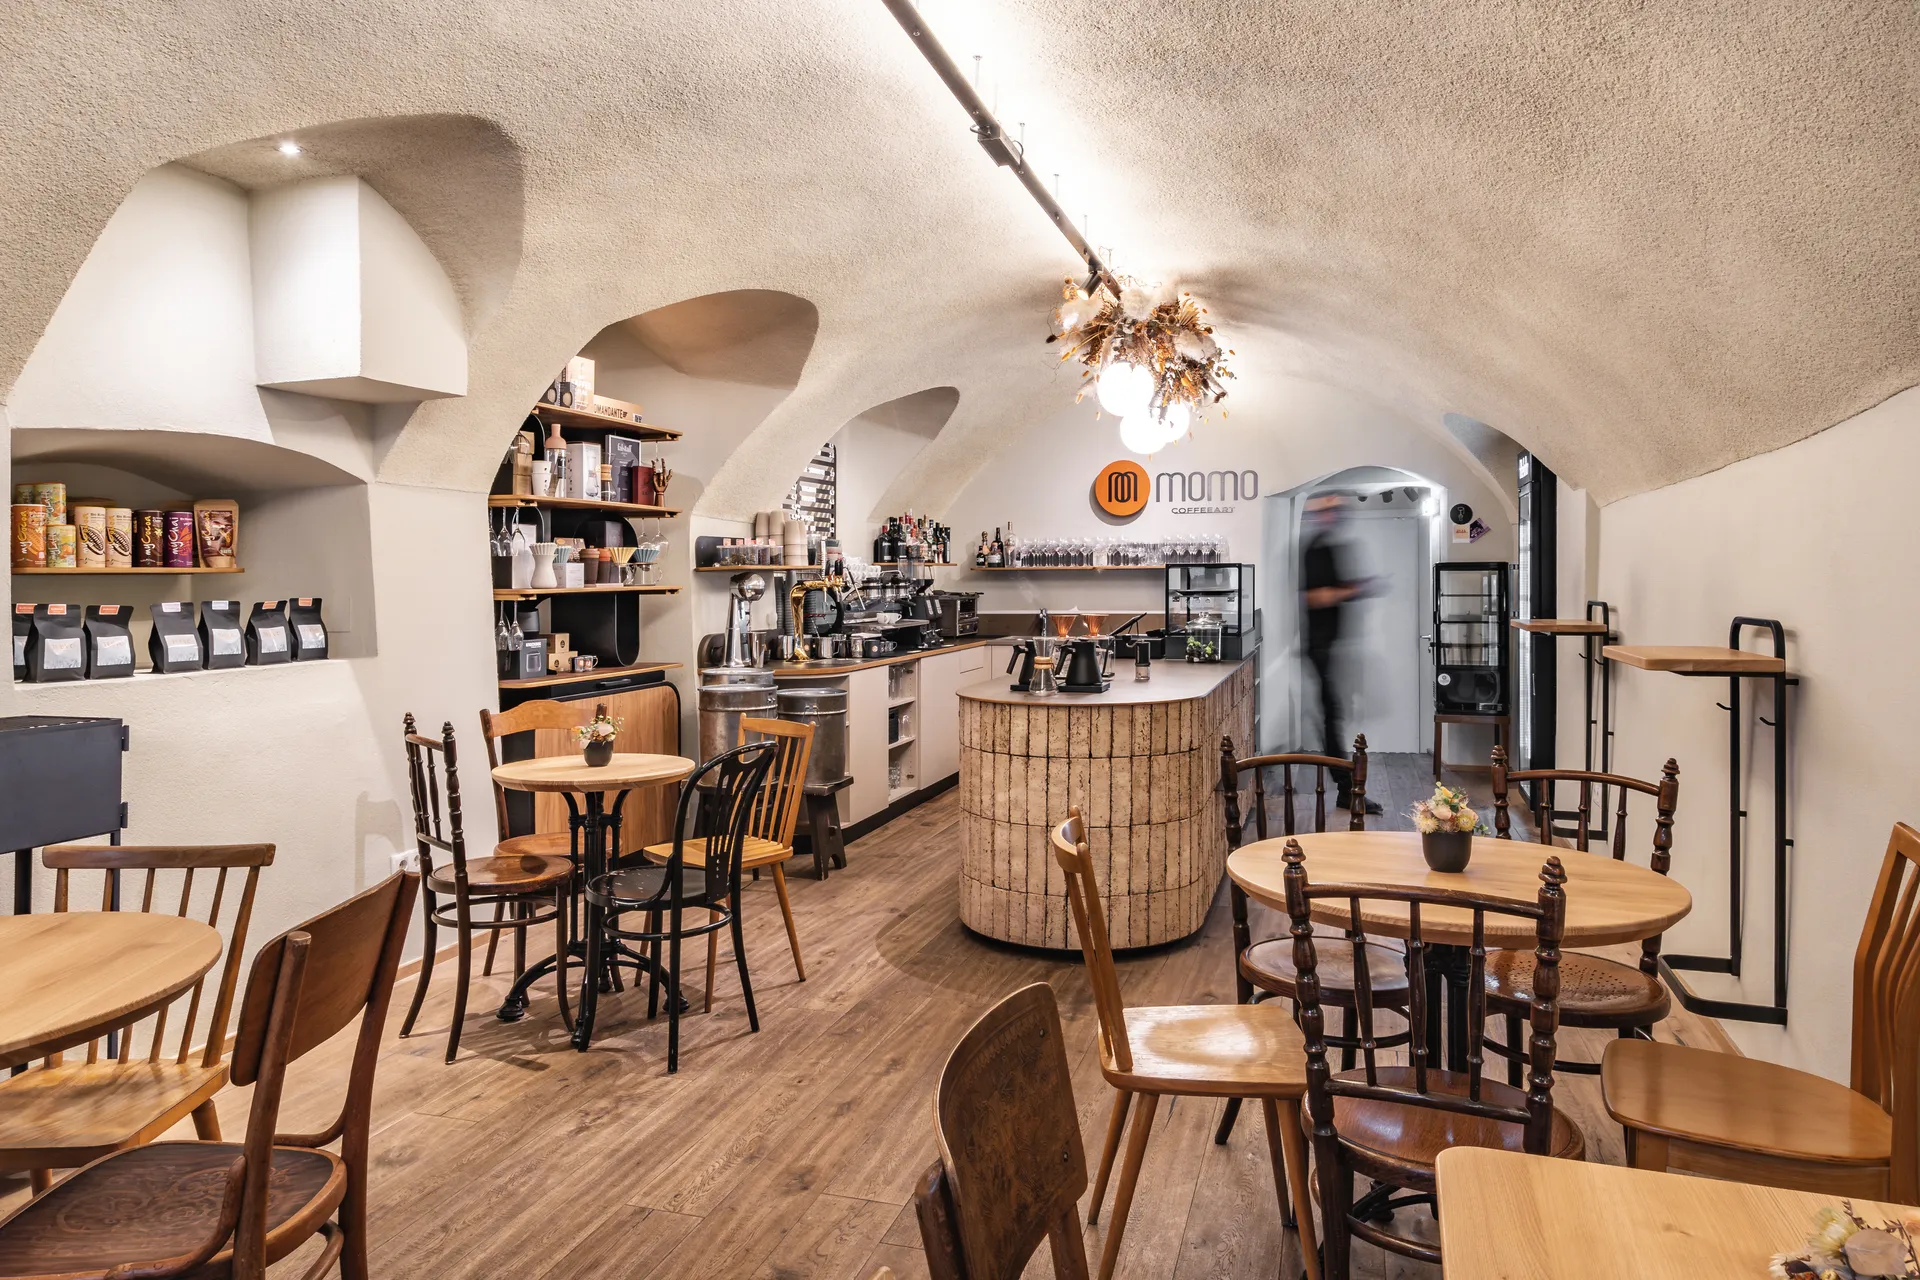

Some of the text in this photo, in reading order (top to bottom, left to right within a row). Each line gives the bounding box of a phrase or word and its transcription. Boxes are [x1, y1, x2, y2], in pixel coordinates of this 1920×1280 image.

[593, 403, 623, 419] OMANDANTE
[141, 515, 156, 555] myCocoa
[168, 516, 184, 555] myChai
